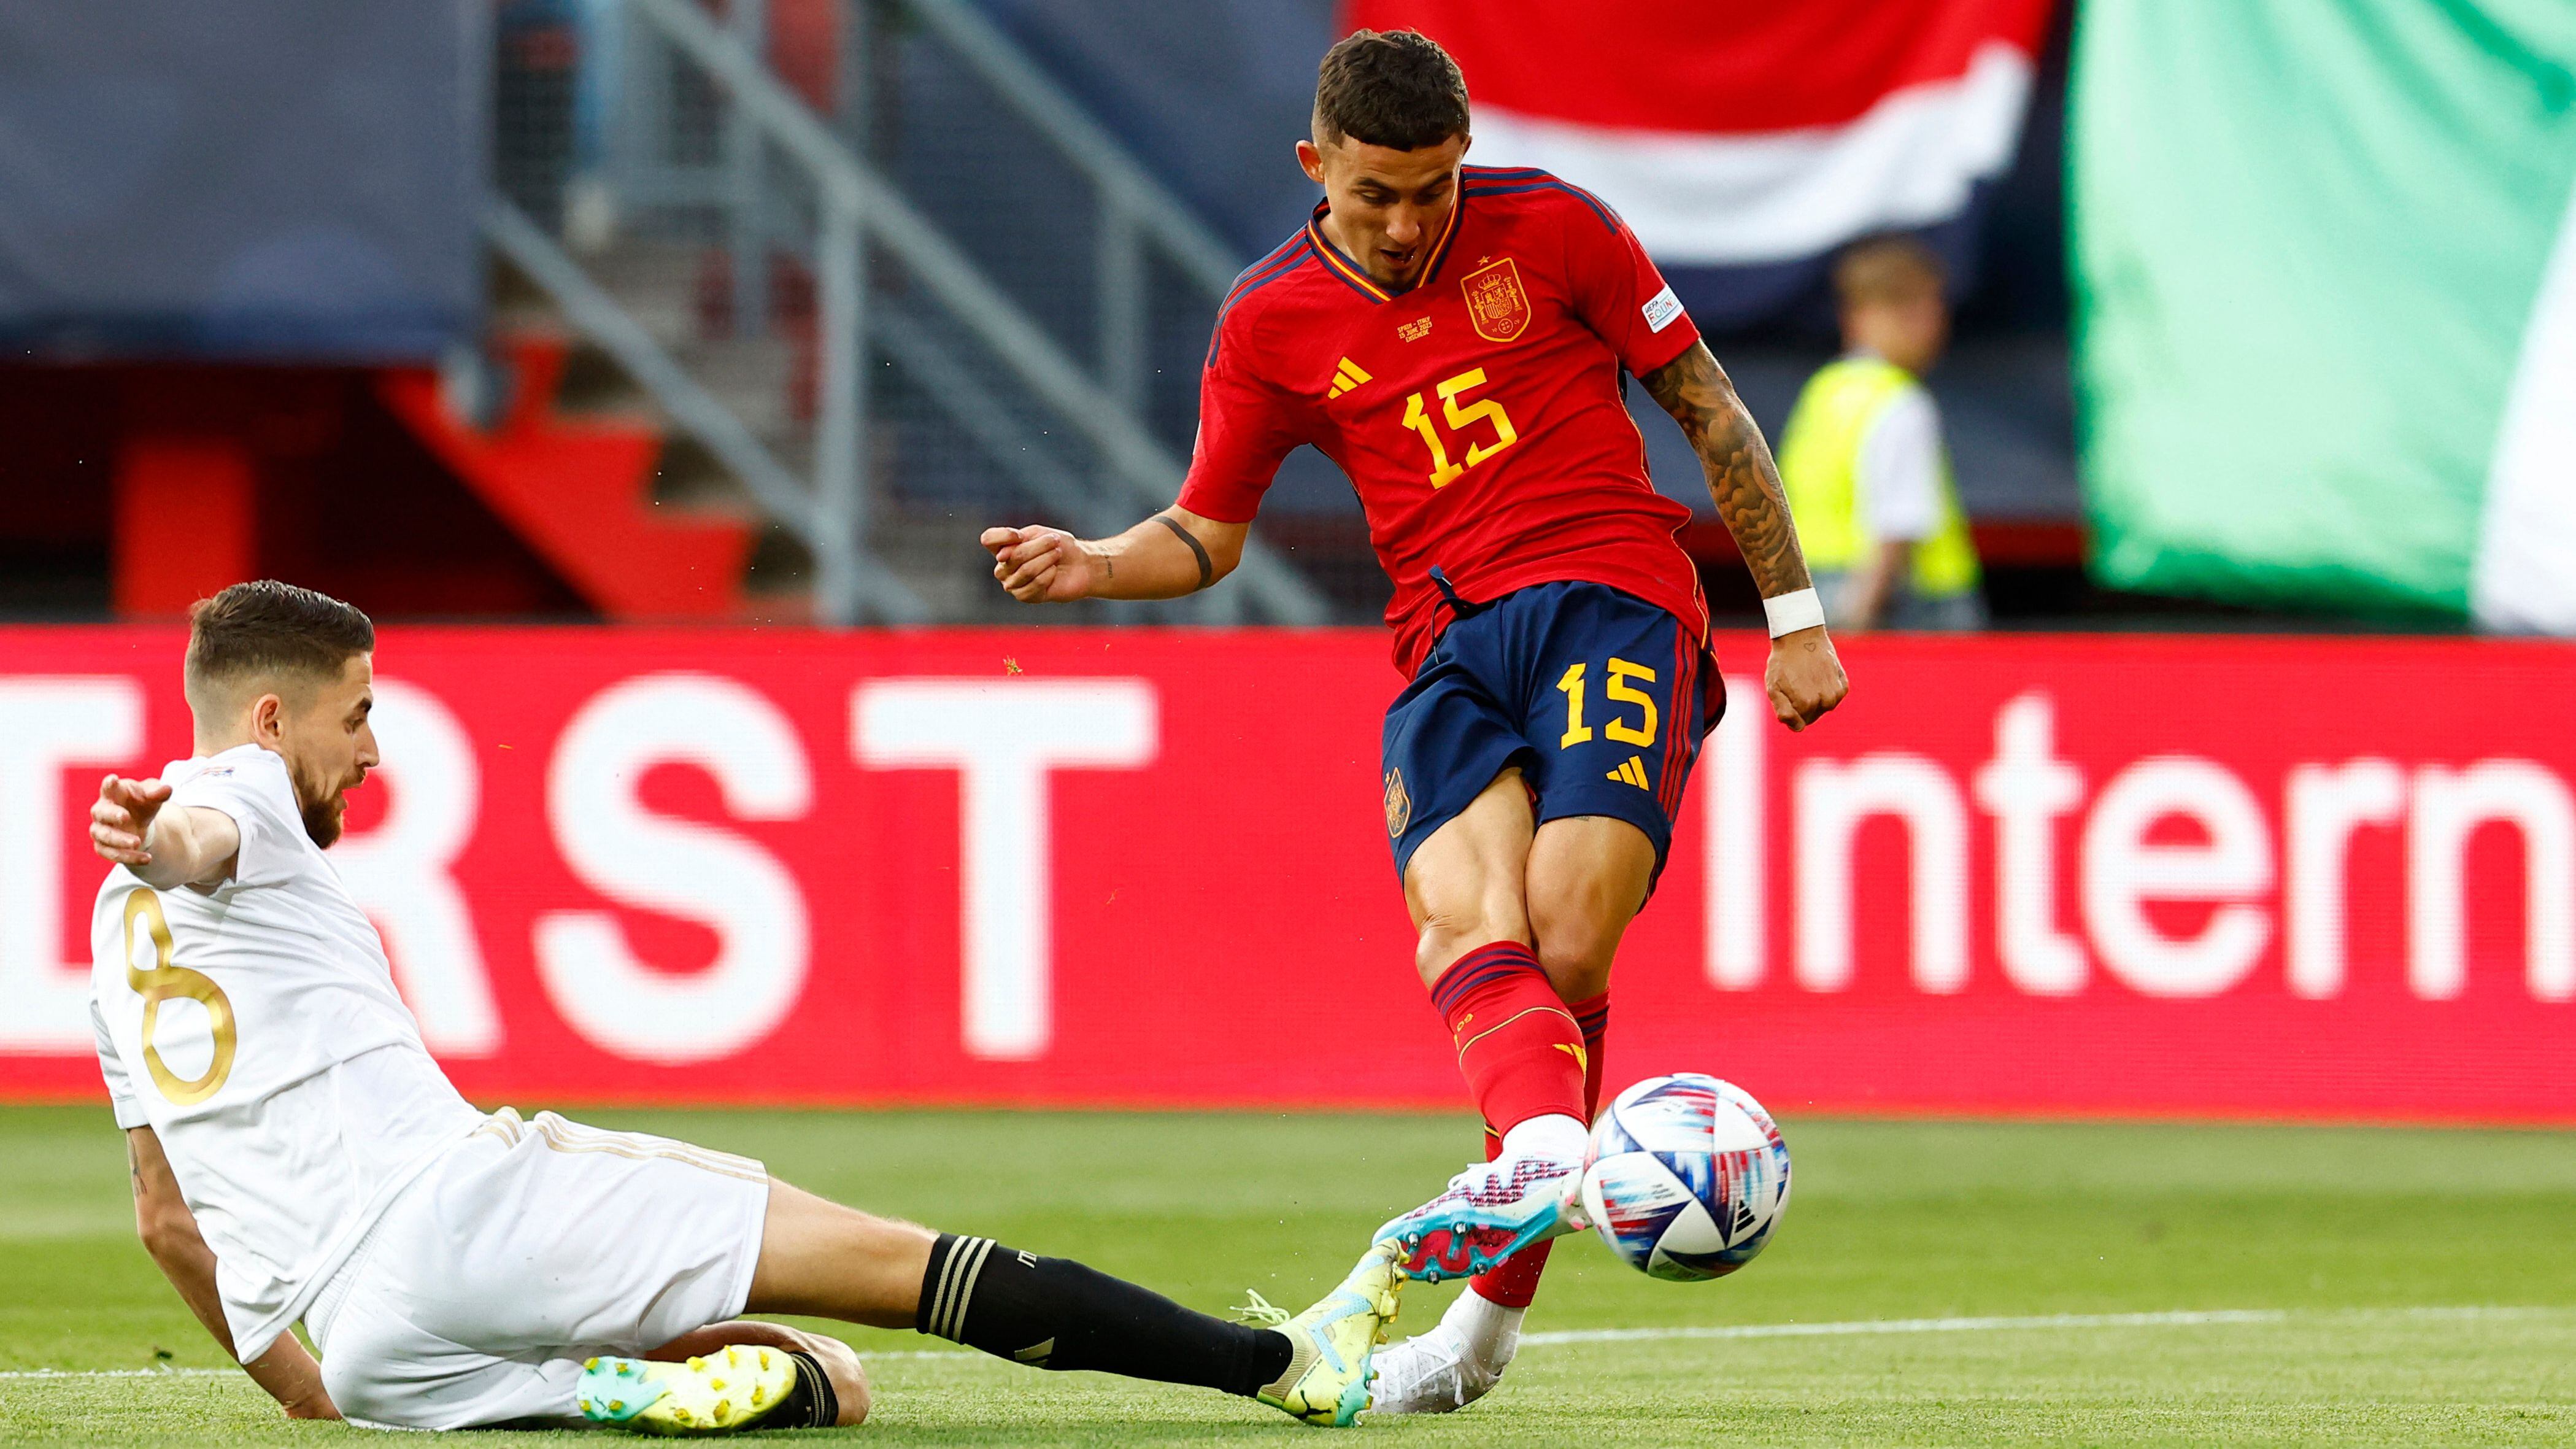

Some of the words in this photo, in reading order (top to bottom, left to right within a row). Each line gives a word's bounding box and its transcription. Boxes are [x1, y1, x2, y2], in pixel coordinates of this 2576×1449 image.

[1645, 300, 1659, 314] UEFA
[1648, 298, 1676, 323] FOUN
[1397, 323, 1413, 333] SPAIN
[1417, 316, 1430, 326] ITALY
[1406, 327, 1418, 336] JUNE
[1406, 329, 1430, 342] ENSCHEDE
[1402, 367, 1517, 489] 15
[1557, 657, 1657, 750] 15
[1701, 672, 2576, 1003] Intern
[123, 887, 237, 1106] 8
